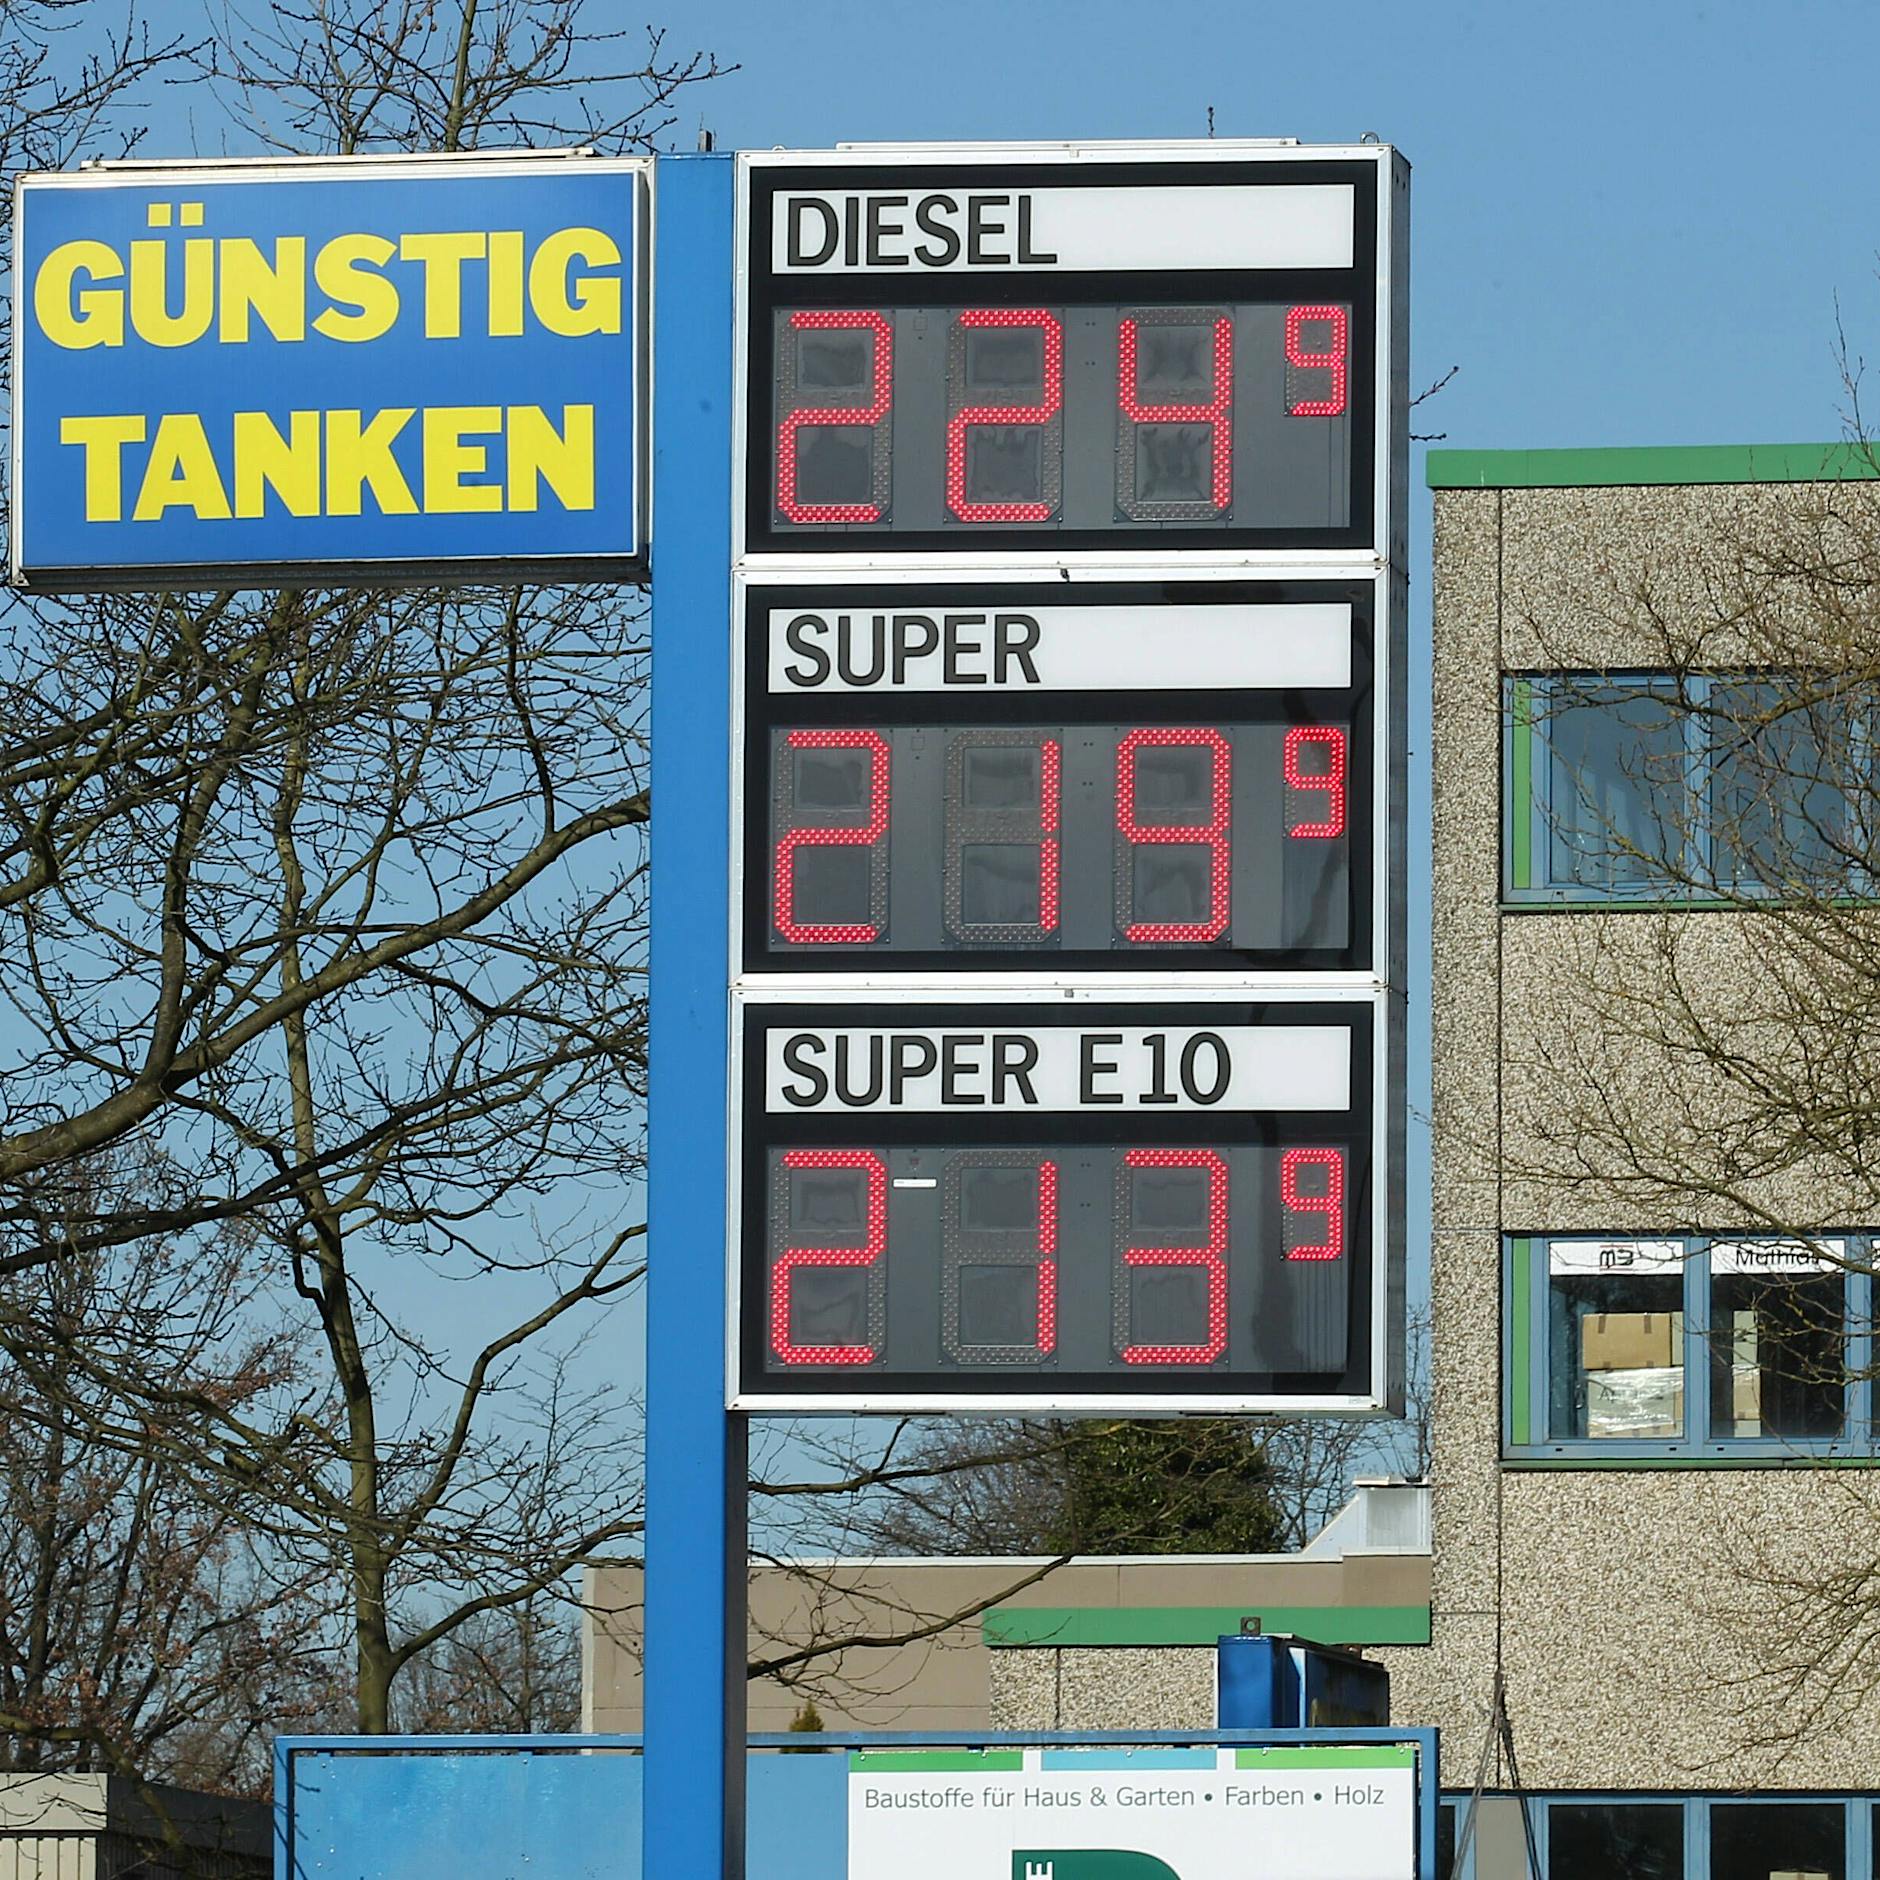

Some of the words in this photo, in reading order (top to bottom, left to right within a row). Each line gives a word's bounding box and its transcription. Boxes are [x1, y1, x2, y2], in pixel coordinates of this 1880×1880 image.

[787, 194, 1058, 268] DIESEL
[34, 202, 622, 349] GÜNSTIG
[60, 404, 595, 523] TANKEN
[784, 613, 1041, 687] SUPER
[781, 1033, 1039, 1108] SUPER
[1079, 1031, 1232, 1106] E10
[865, 1787, 974, 1809] Baustoffe
[983, 1786, 1015, 1808] für
[1024, 1787, 1082, 1807] Haus
[1090, 1786, 1107, 1807] &
[1116, 1786, 1194, 1807] Garten
[1225, 1785, 1304, 1806] Farben
[1335, 1784, 1384, 1805] Holz
